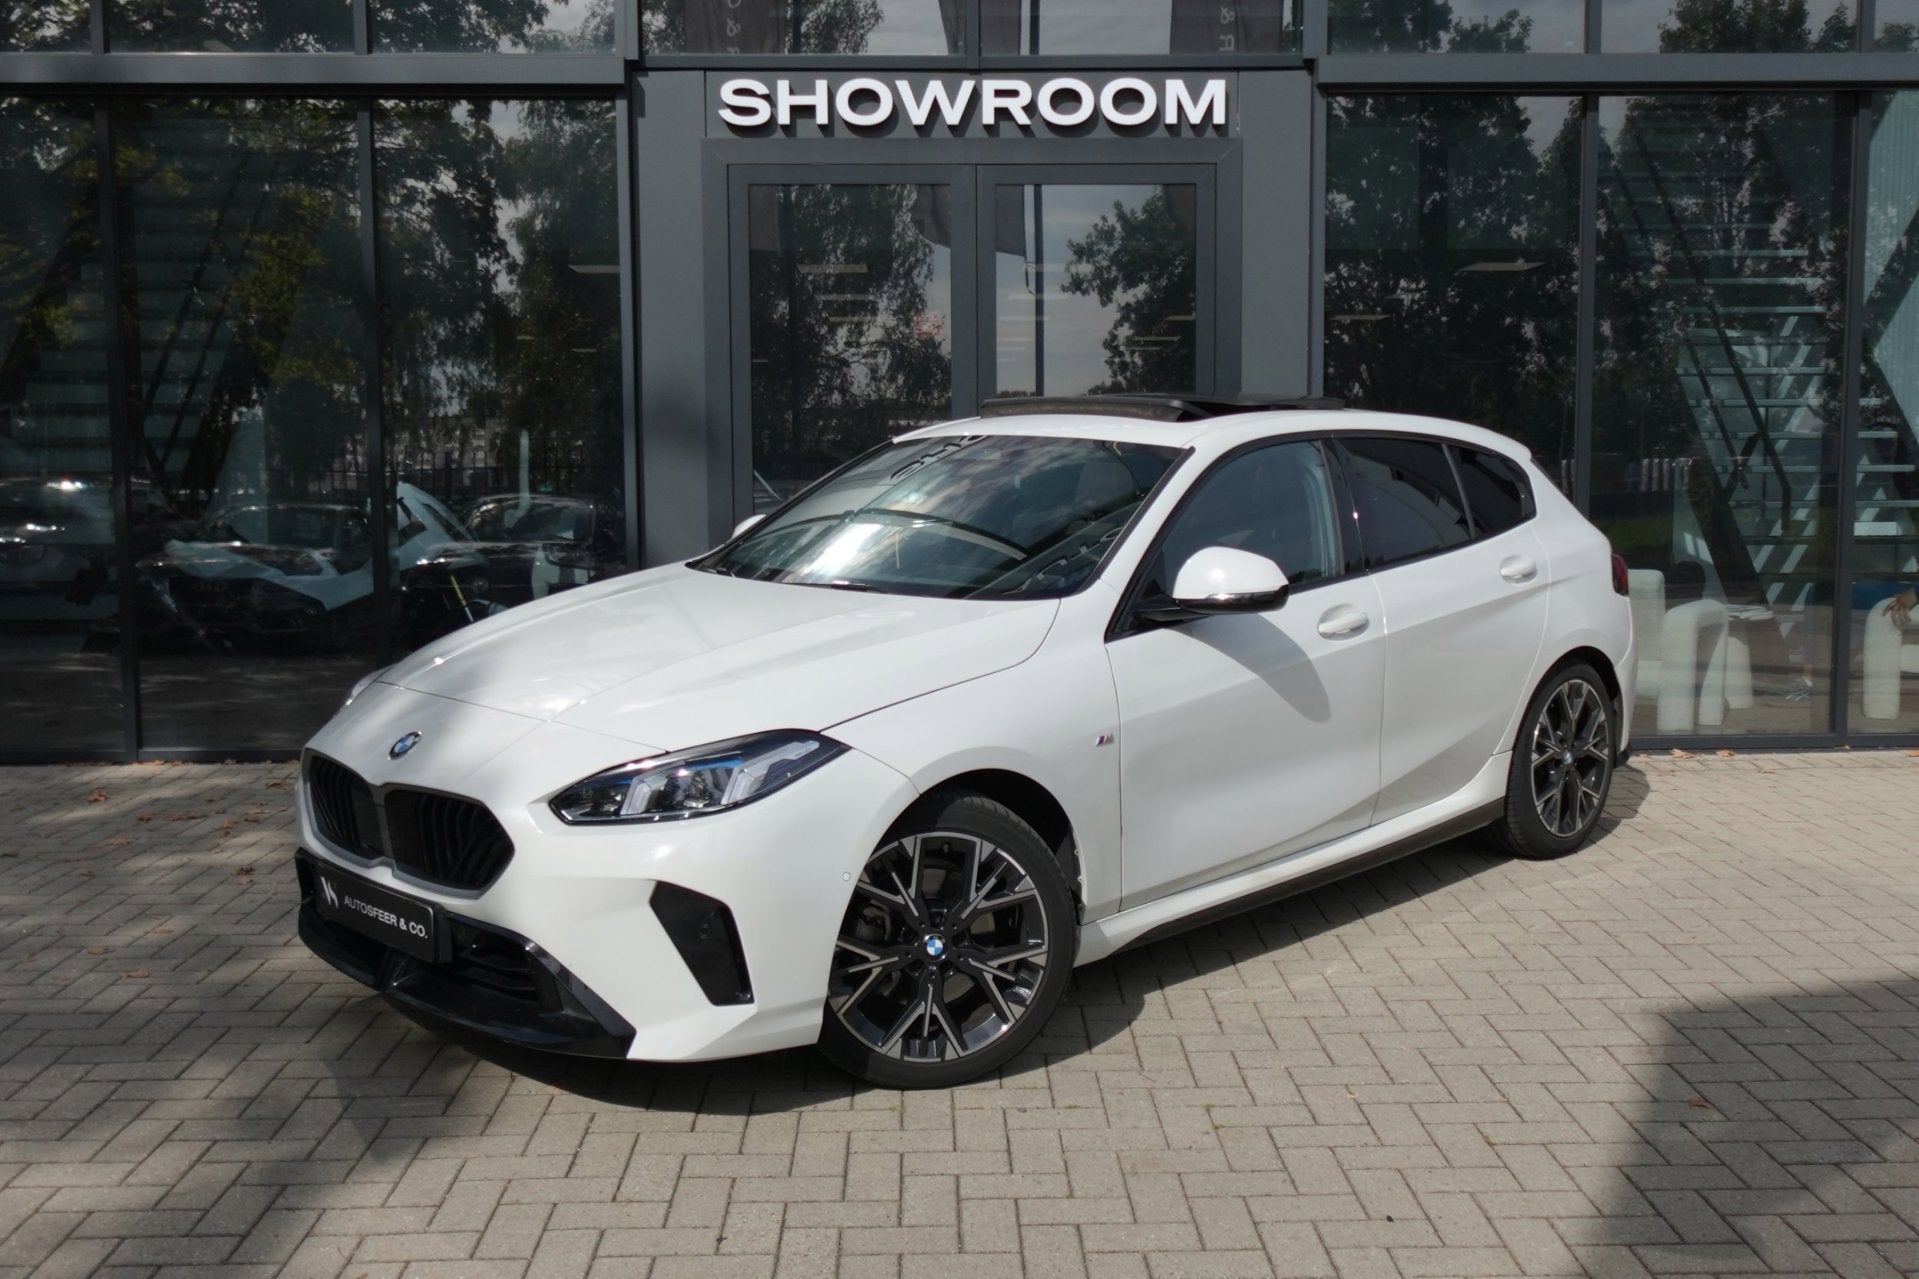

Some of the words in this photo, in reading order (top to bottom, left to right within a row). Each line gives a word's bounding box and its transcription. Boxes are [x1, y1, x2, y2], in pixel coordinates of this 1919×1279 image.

[718, 77, 1227, 127] SHOWROOM
[344, 895, 398, 927] AUTOSFEER
[399, 918, 408, 931] &
